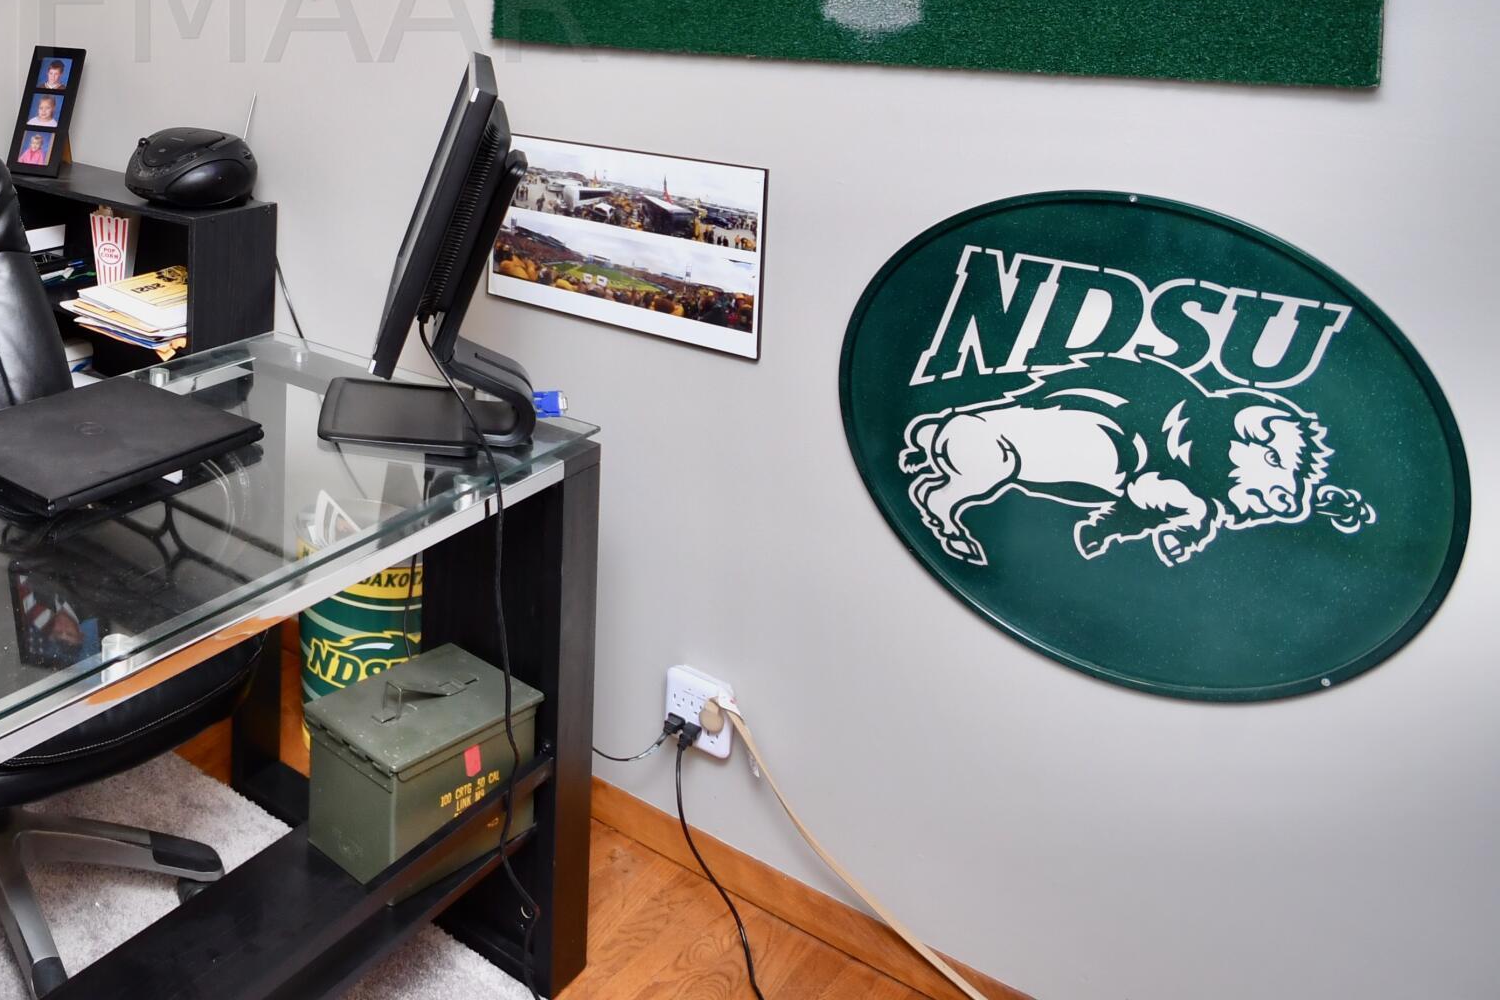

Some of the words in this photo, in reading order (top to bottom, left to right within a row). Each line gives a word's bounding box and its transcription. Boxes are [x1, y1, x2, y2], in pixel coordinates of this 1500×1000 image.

[100, 252, 119, 260] CORN
[909, 245, 1353, 389] NDSU
[441, 792, 452, 807] 100
[455, 783, 472, 800] CRTG
[488, 770, 499, 783] CAL
[456, 795, 472, 811] LINK
